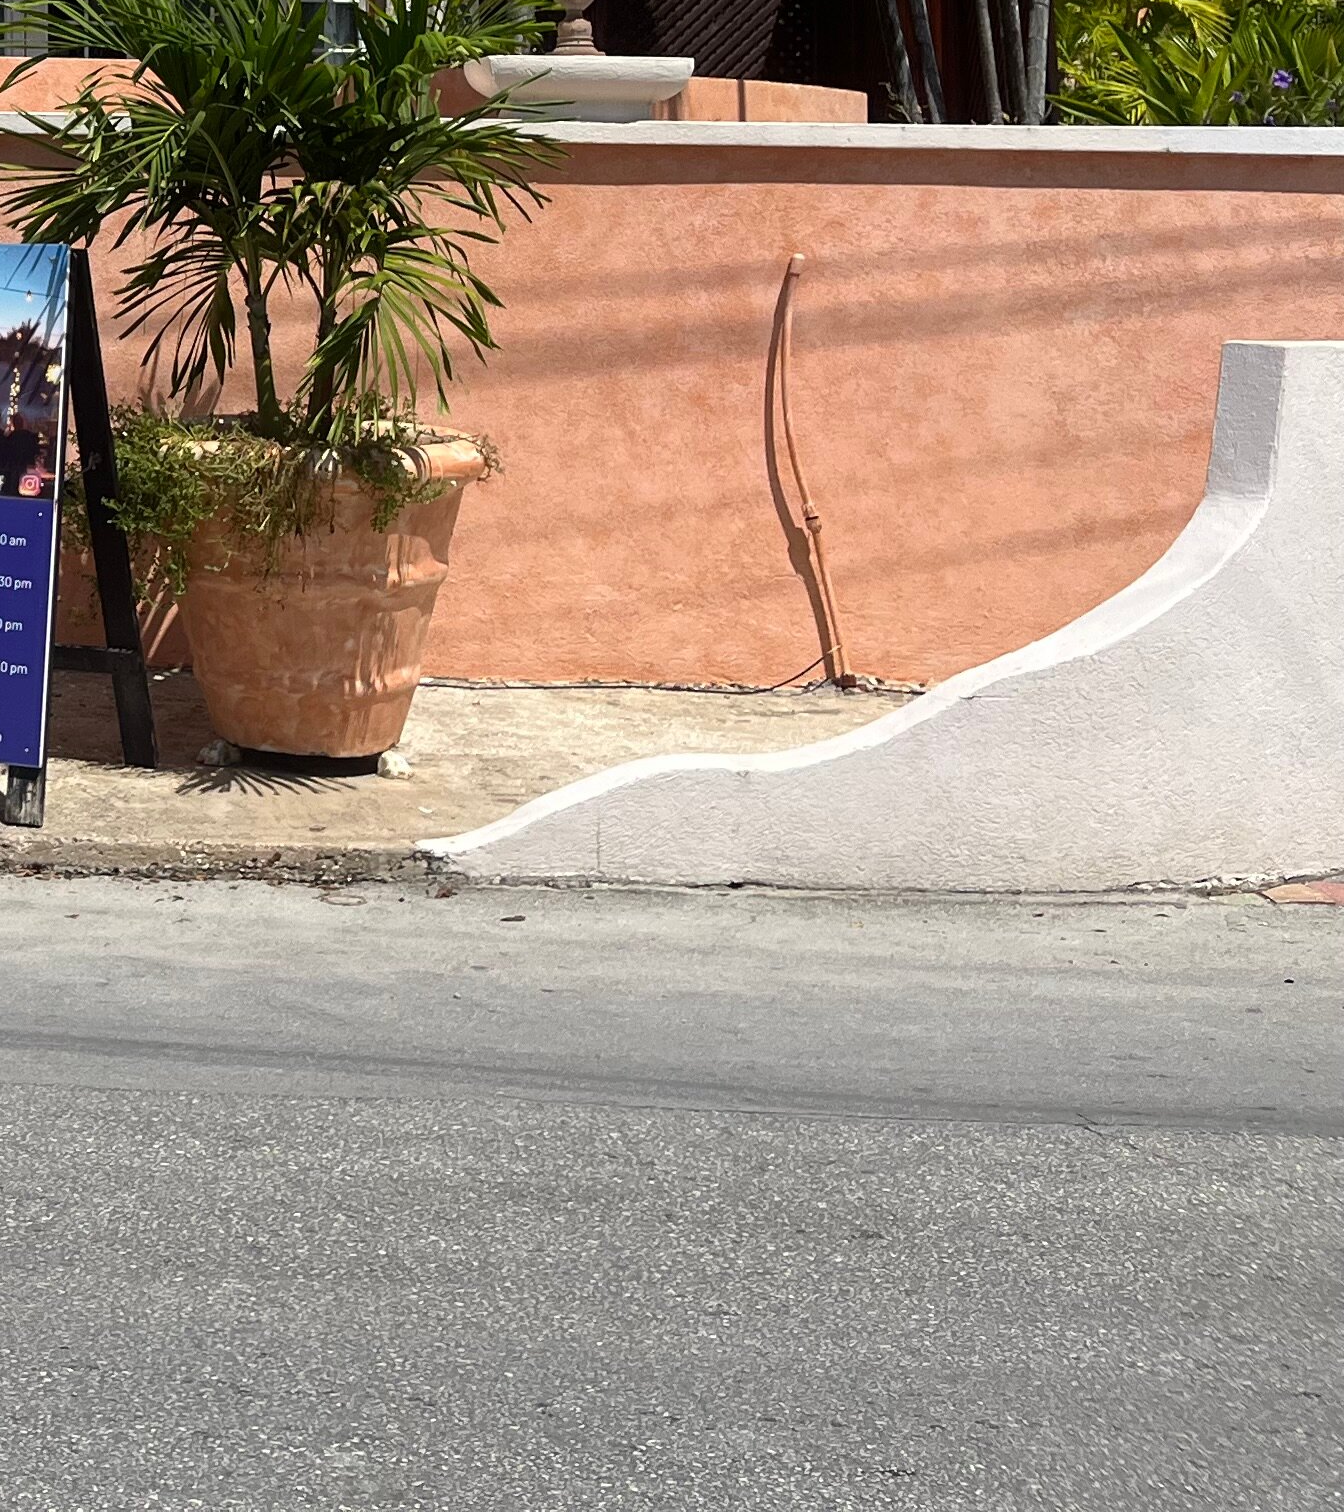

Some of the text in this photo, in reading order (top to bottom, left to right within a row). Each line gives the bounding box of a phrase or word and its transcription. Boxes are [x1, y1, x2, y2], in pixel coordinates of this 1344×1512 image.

[9, 537, 26, 546] am
[14, 580, 31, 590] pm
[5, 622, 22, 632] pm
[10, 665, 27, 675] pm
